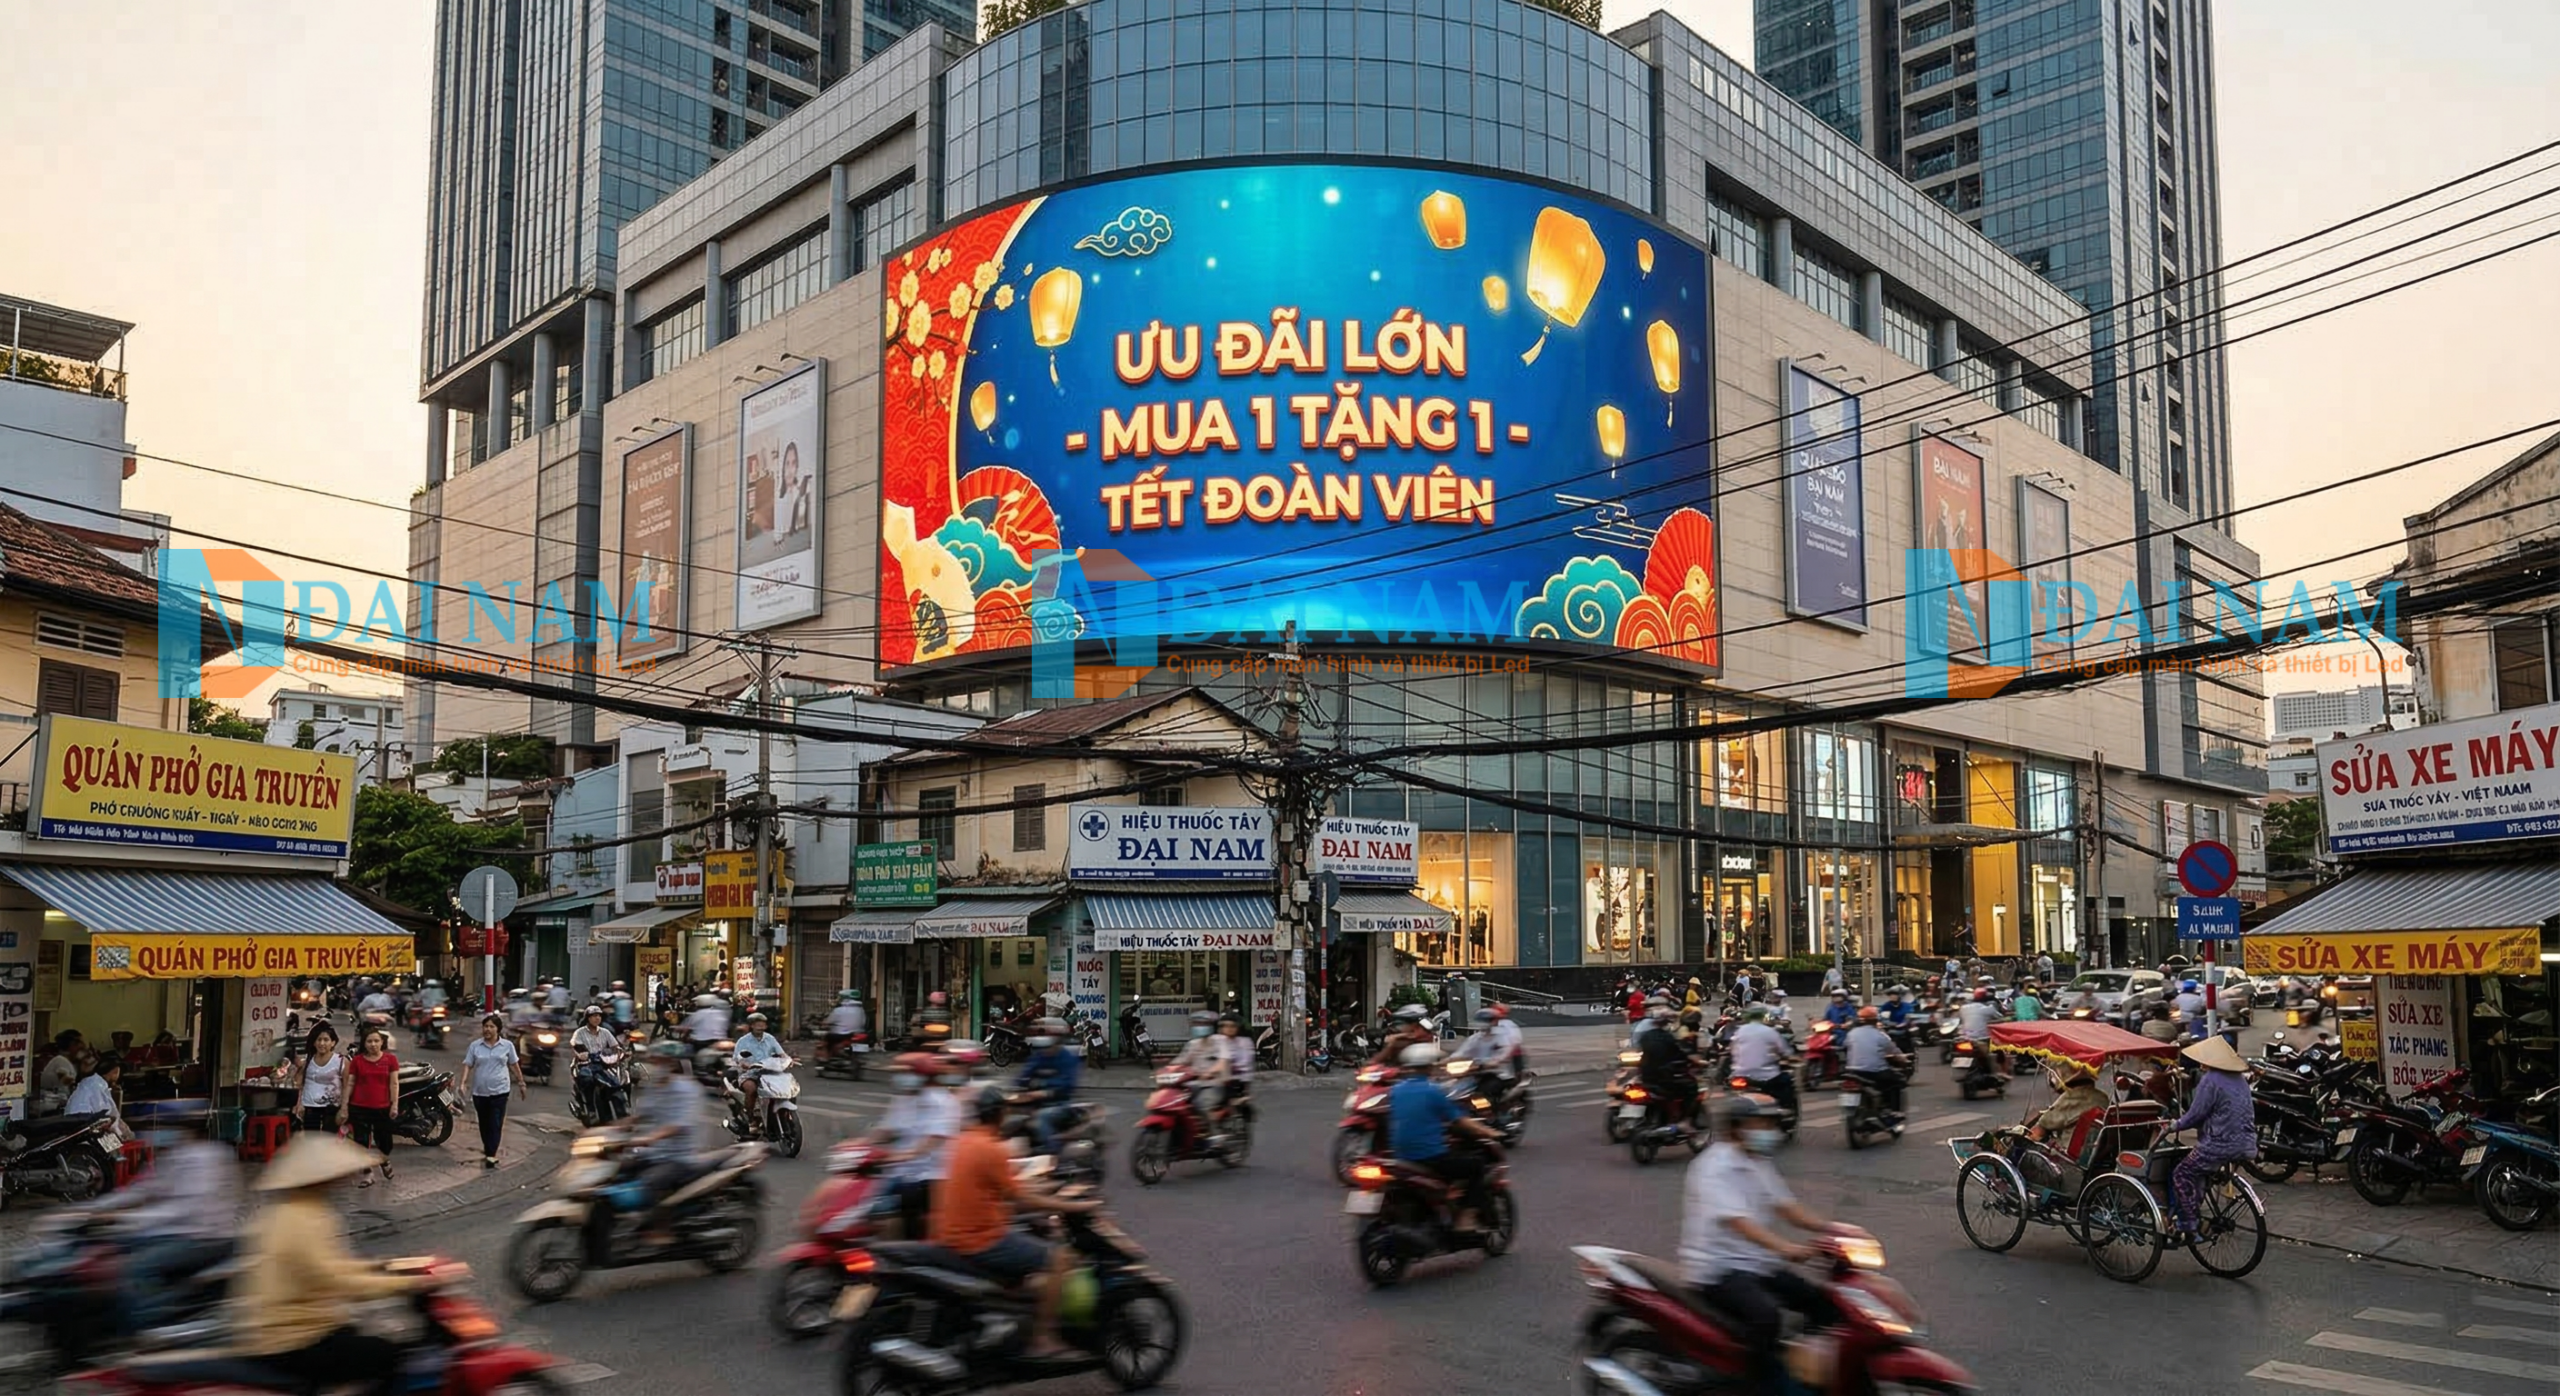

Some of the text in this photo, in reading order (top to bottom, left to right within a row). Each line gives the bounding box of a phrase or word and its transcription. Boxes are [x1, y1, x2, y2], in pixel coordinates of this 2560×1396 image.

[1116, 307, 1467, 384] ƯU ĐÃI LỚN
[1101, 399, 1240, 461] MUA
[1251, 395, 1276, 449] 1
[1289, 381, 1459, 461] TẶNG
[1469, 399, 1494, 453] 1
[1101, 462, 1495, 532] TẾT ĐOÀN VIÊN
[62, 738, 342, 810] QUÁN PHỞ GIA TRUYỀN
[2331, 720, 2560, 796] SỬA XE MÁY
[1122, 809, 1261, 832] HIỆU THUỐC TÂY
[1327, 819, 1352, 834] HIỆU
[1355, 821, 1388, 836] THUỐC
[1117, 837, 1266, 867] ĐẠI NAM
[1321, 838, 1412, 862] ĐẠI NAM
[138, 940, 204, 975] QUÁN
[213, 937, 258, 970] PHỞ
[264, 947, 298, 969] GIA
[304, 938, 381, 969] TRUYỀN
[1203, 934, 1232, 949] ĐẠI
[1236, 934, 1274, 946] NAM
[2277, 937, 2340, 970] SỬA
[2351, 944, 2395, 969] XE
[2408, 935, 2491, 969] MÁY
[2421, 1004, 2444, 1026] XE
[2412, 1037, 2448, 1057] PHANG
